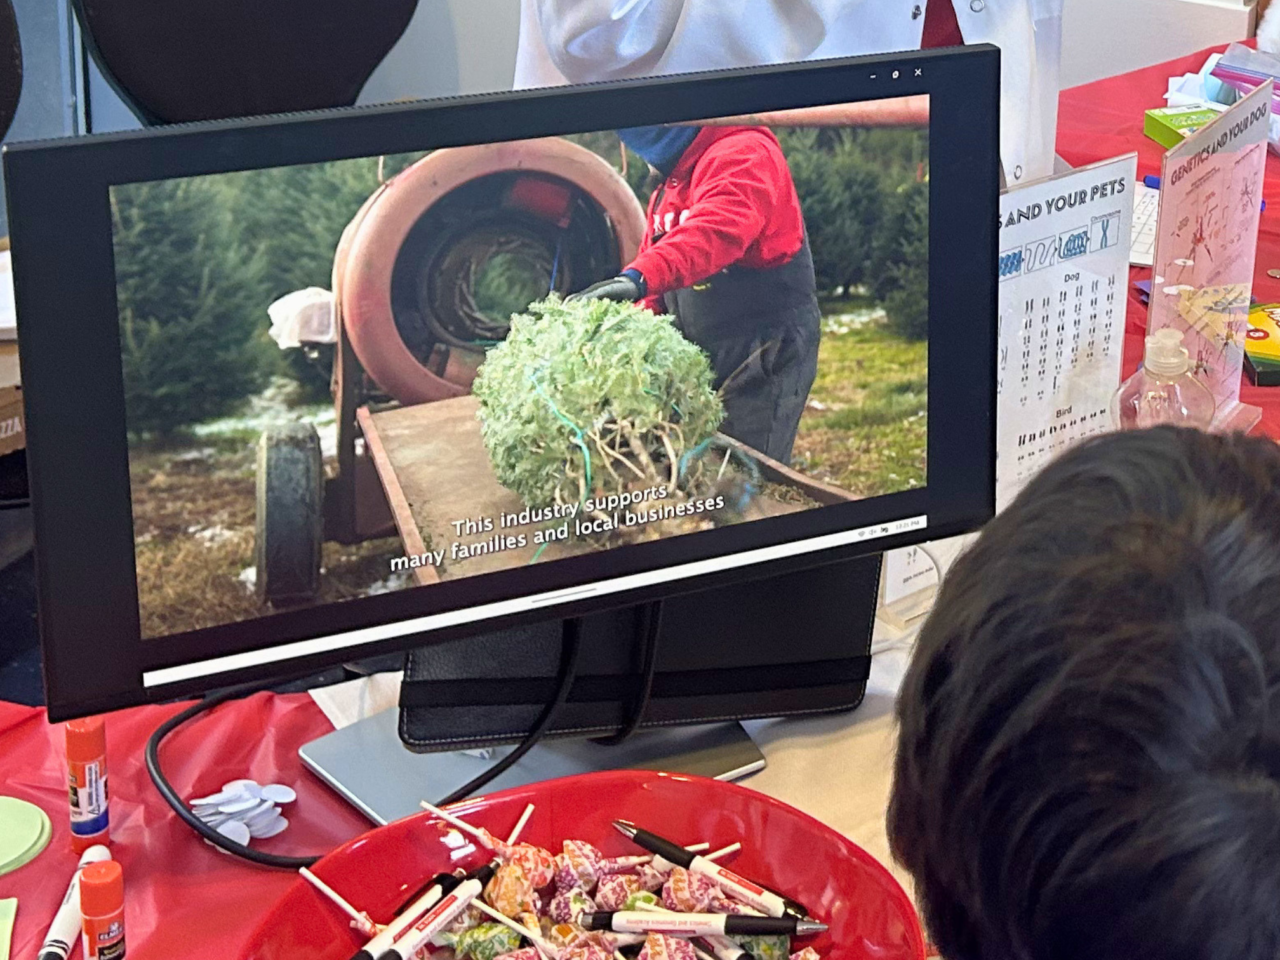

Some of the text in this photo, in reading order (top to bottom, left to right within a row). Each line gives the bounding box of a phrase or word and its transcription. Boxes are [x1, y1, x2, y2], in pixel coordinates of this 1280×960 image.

[1171, 144, 1211, 186] GENETICS
[1211, 130, 1228, 156] AND
[1228, 115, 1249, 142] YOUR
[1250, 102, 1267, 126] DOG
[1004, 202, 1042, 228] AND
[1045, 189, 1088, 215] YOUR
[1090, 177, 1125, 201] PETS
[1064, 272, 1080, 283] Dog
[1255, 331, 1264, 339] 8
[1056, 405, 1072, 418] Bird
[390, 495, 724, 571] many families and local businesses
[451, 485, 668, 536] This industry supports
